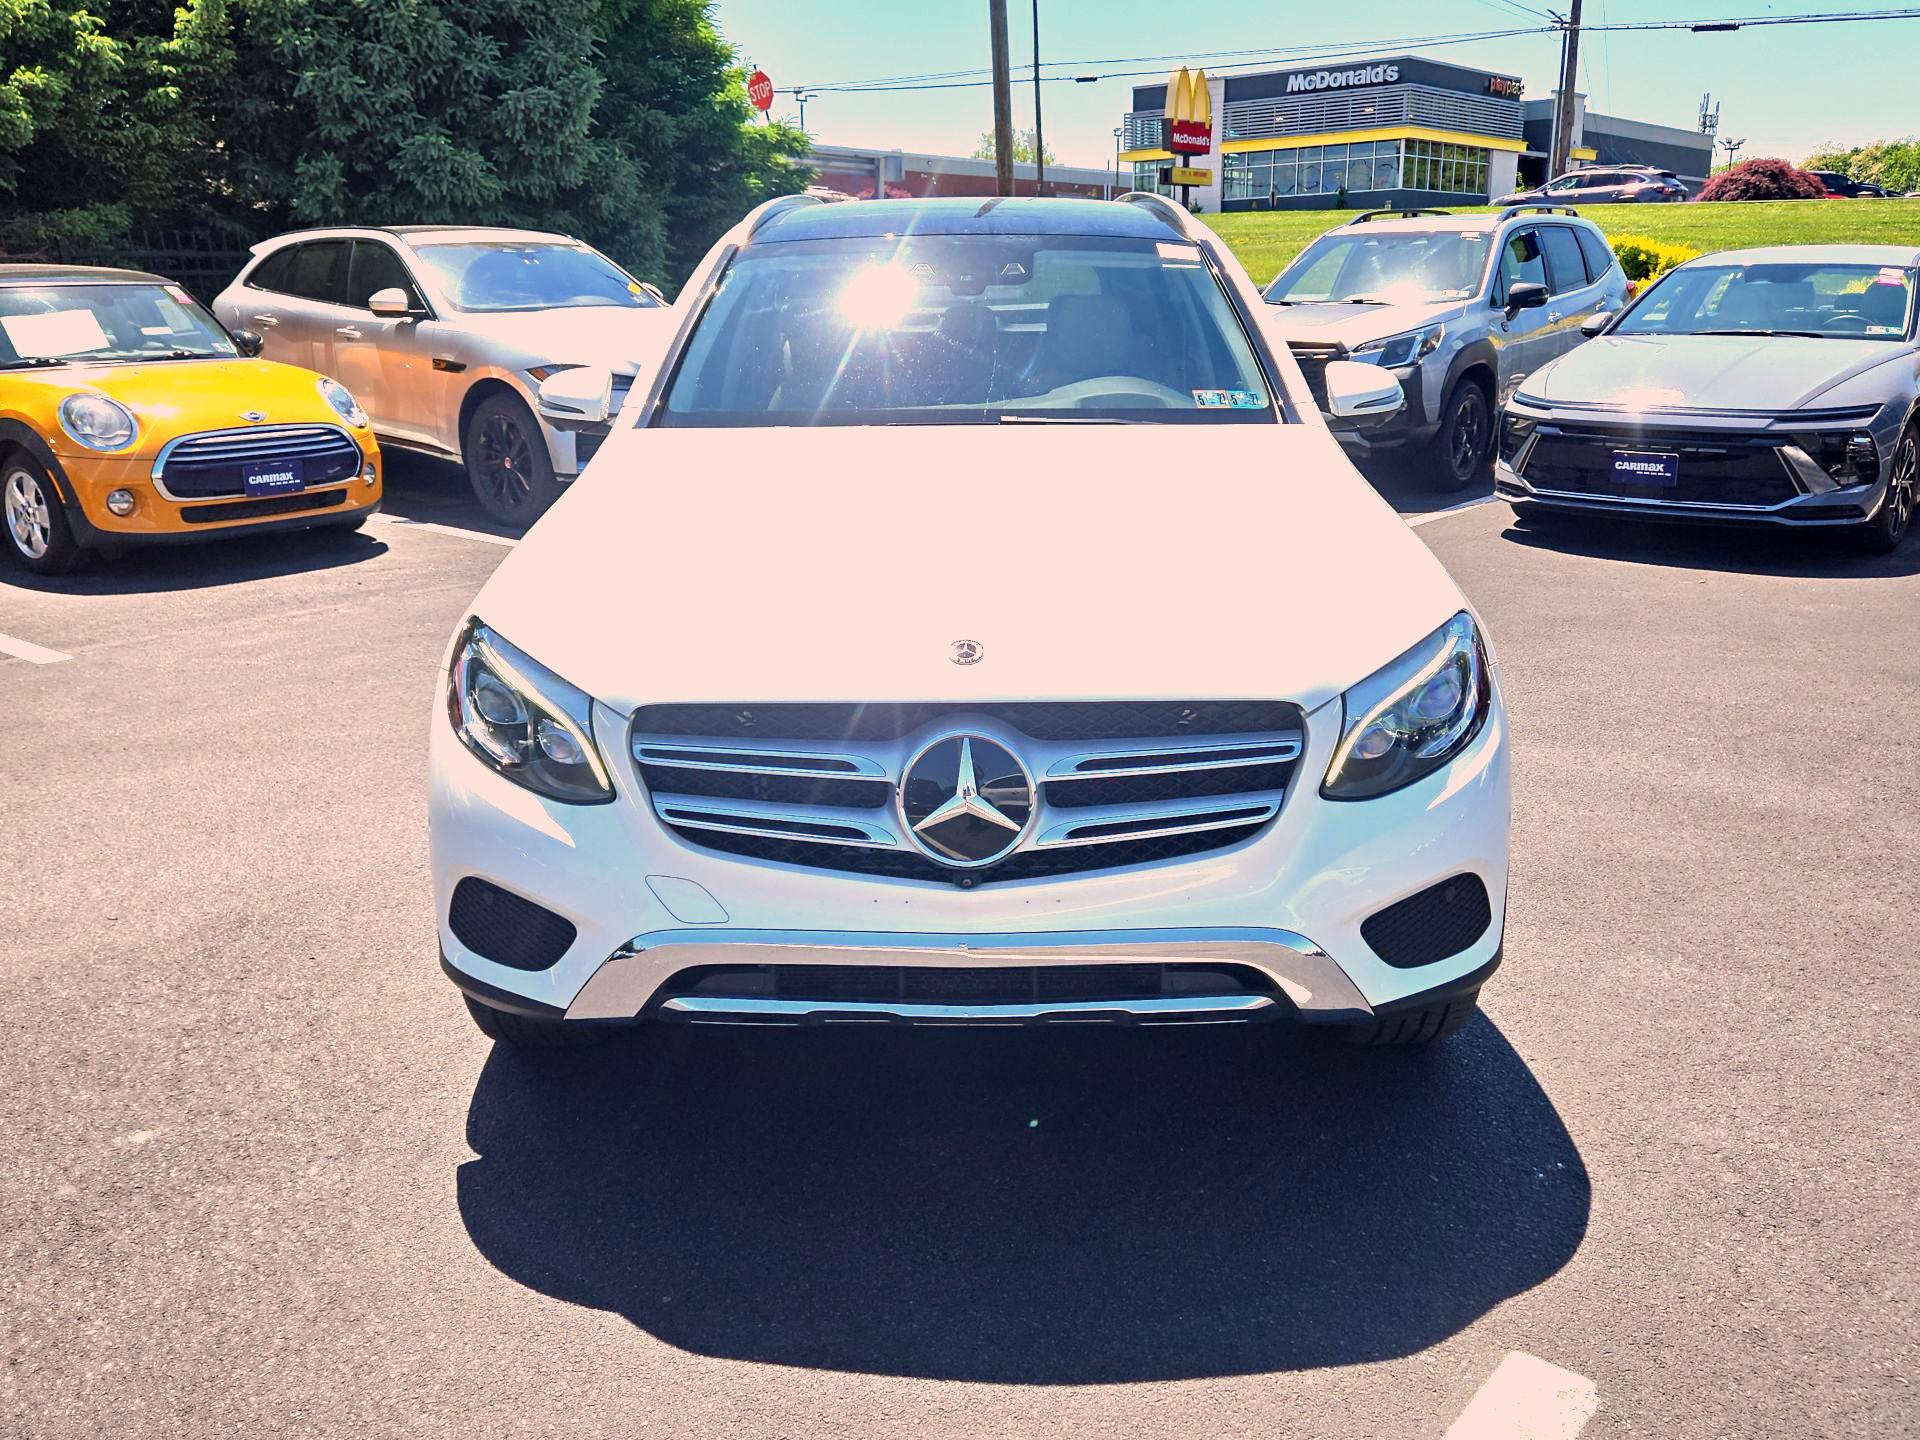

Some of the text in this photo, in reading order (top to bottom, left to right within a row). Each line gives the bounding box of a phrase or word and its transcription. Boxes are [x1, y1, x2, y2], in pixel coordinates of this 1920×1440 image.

[1286, 64, 1399, 92] McDonald's
[750, 81, 771, 102] STOP
[1173, 132, 1210, 146] McDonald's
